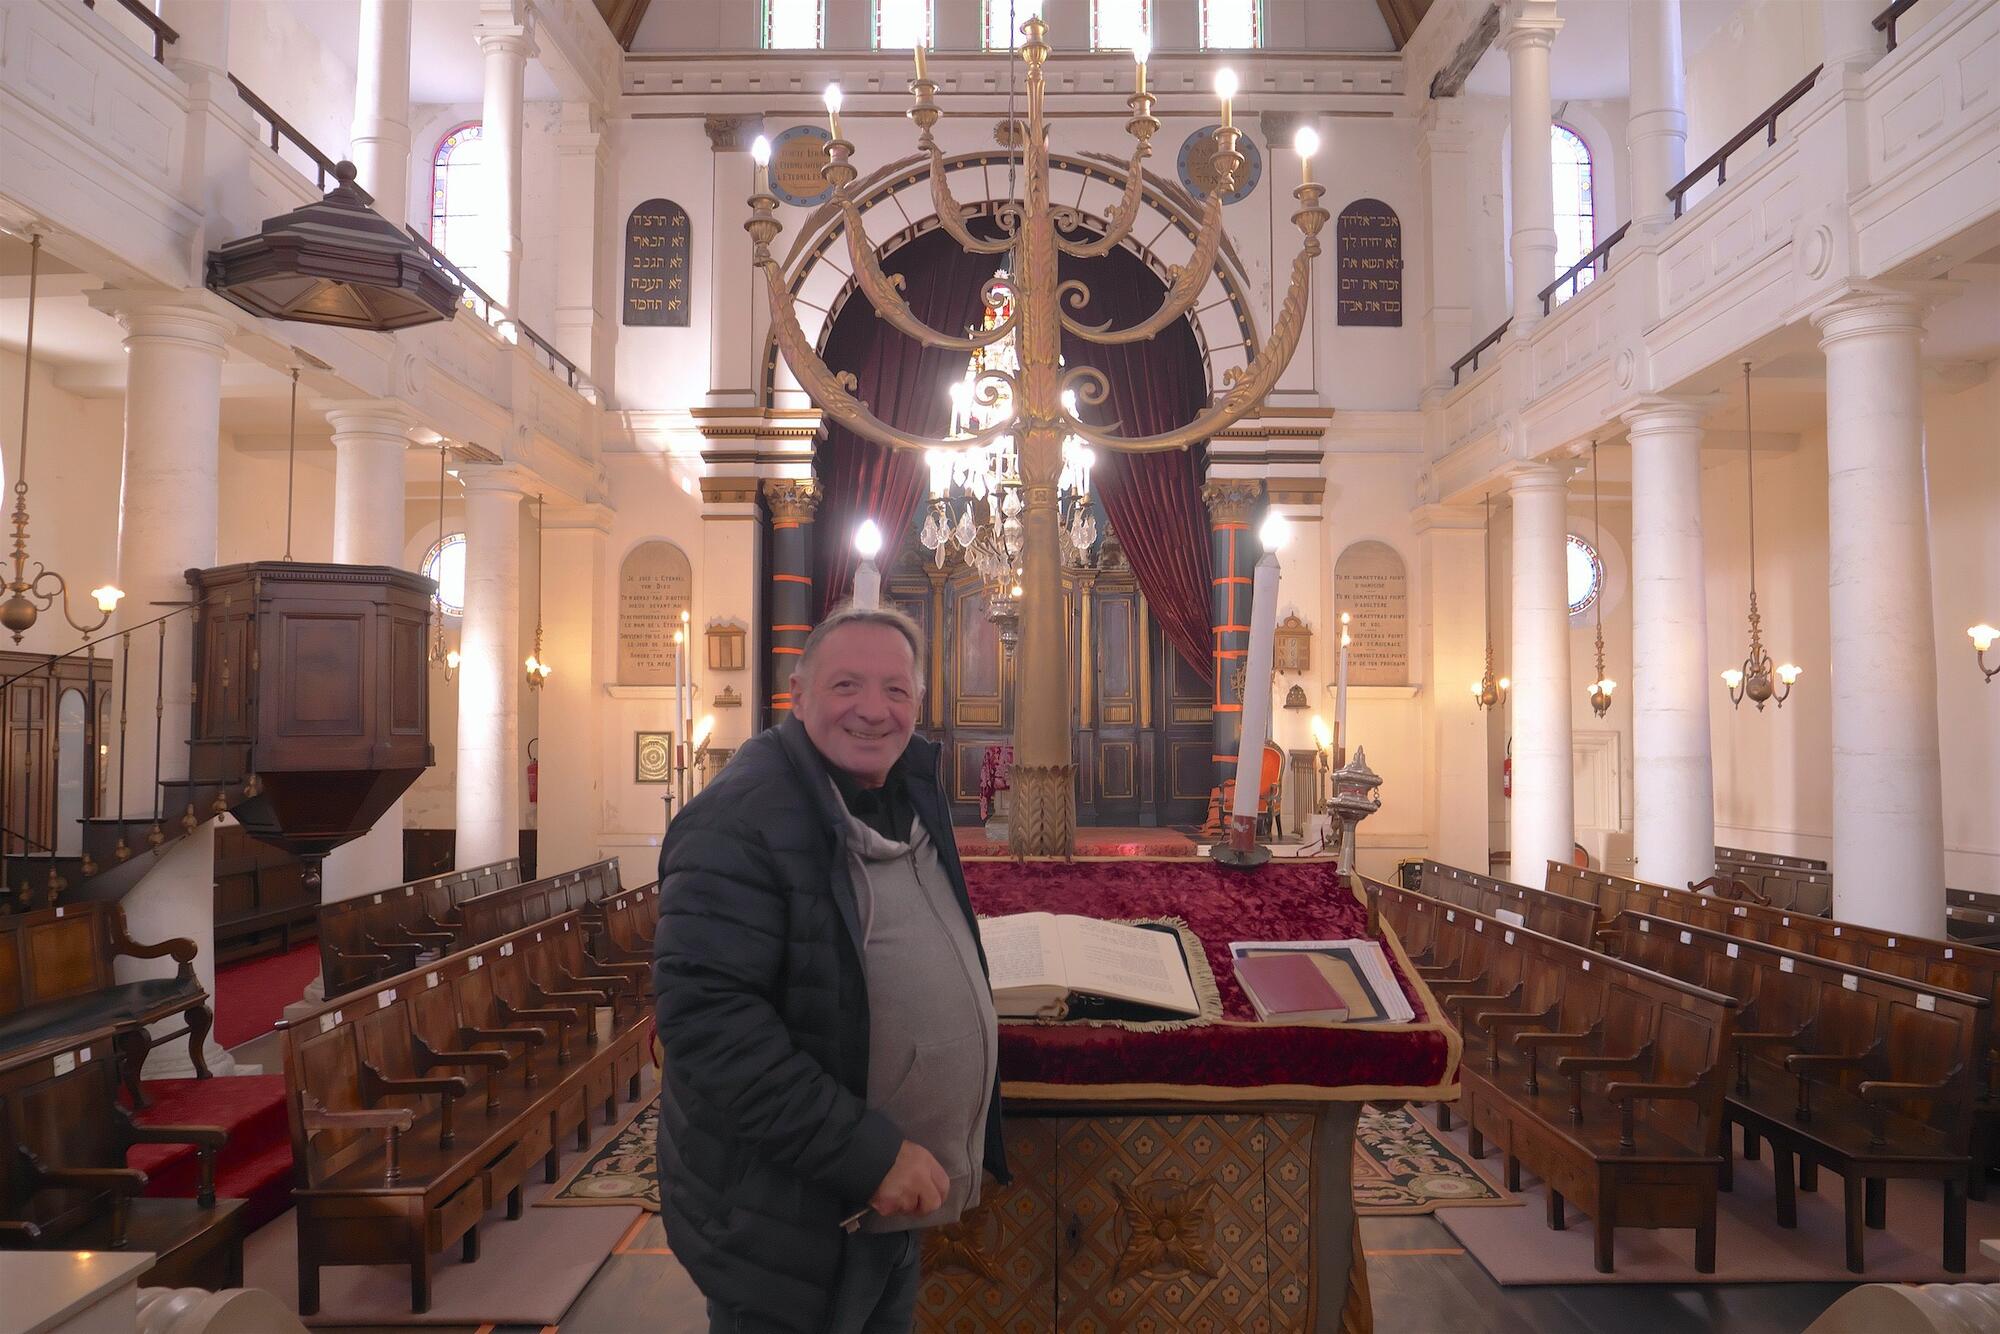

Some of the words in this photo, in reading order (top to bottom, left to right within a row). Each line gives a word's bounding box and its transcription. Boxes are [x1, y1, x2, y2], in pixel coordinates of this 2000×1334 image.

[632, 215, 666, 226] תרצח
[672, 210, 685, 226] לא
[672, 232, 684, 248] לא
[1384, 233, 1397, 248] לא
[670, 253, 682, 268] לא
[1343, 258, 1358, 268] את
[1362, 258, 1384, 269] תשא
[1386, 254, 1399, 269] לא
[668, 274, 682, 290] לא
[1342, 279, 1358, 290] יום
[1362, 280, 1378, 290] את
[630, 299, 662, 310] תחמד
[668, 295, 681, 310] לא
[1364, 300, 1380, 312] את
